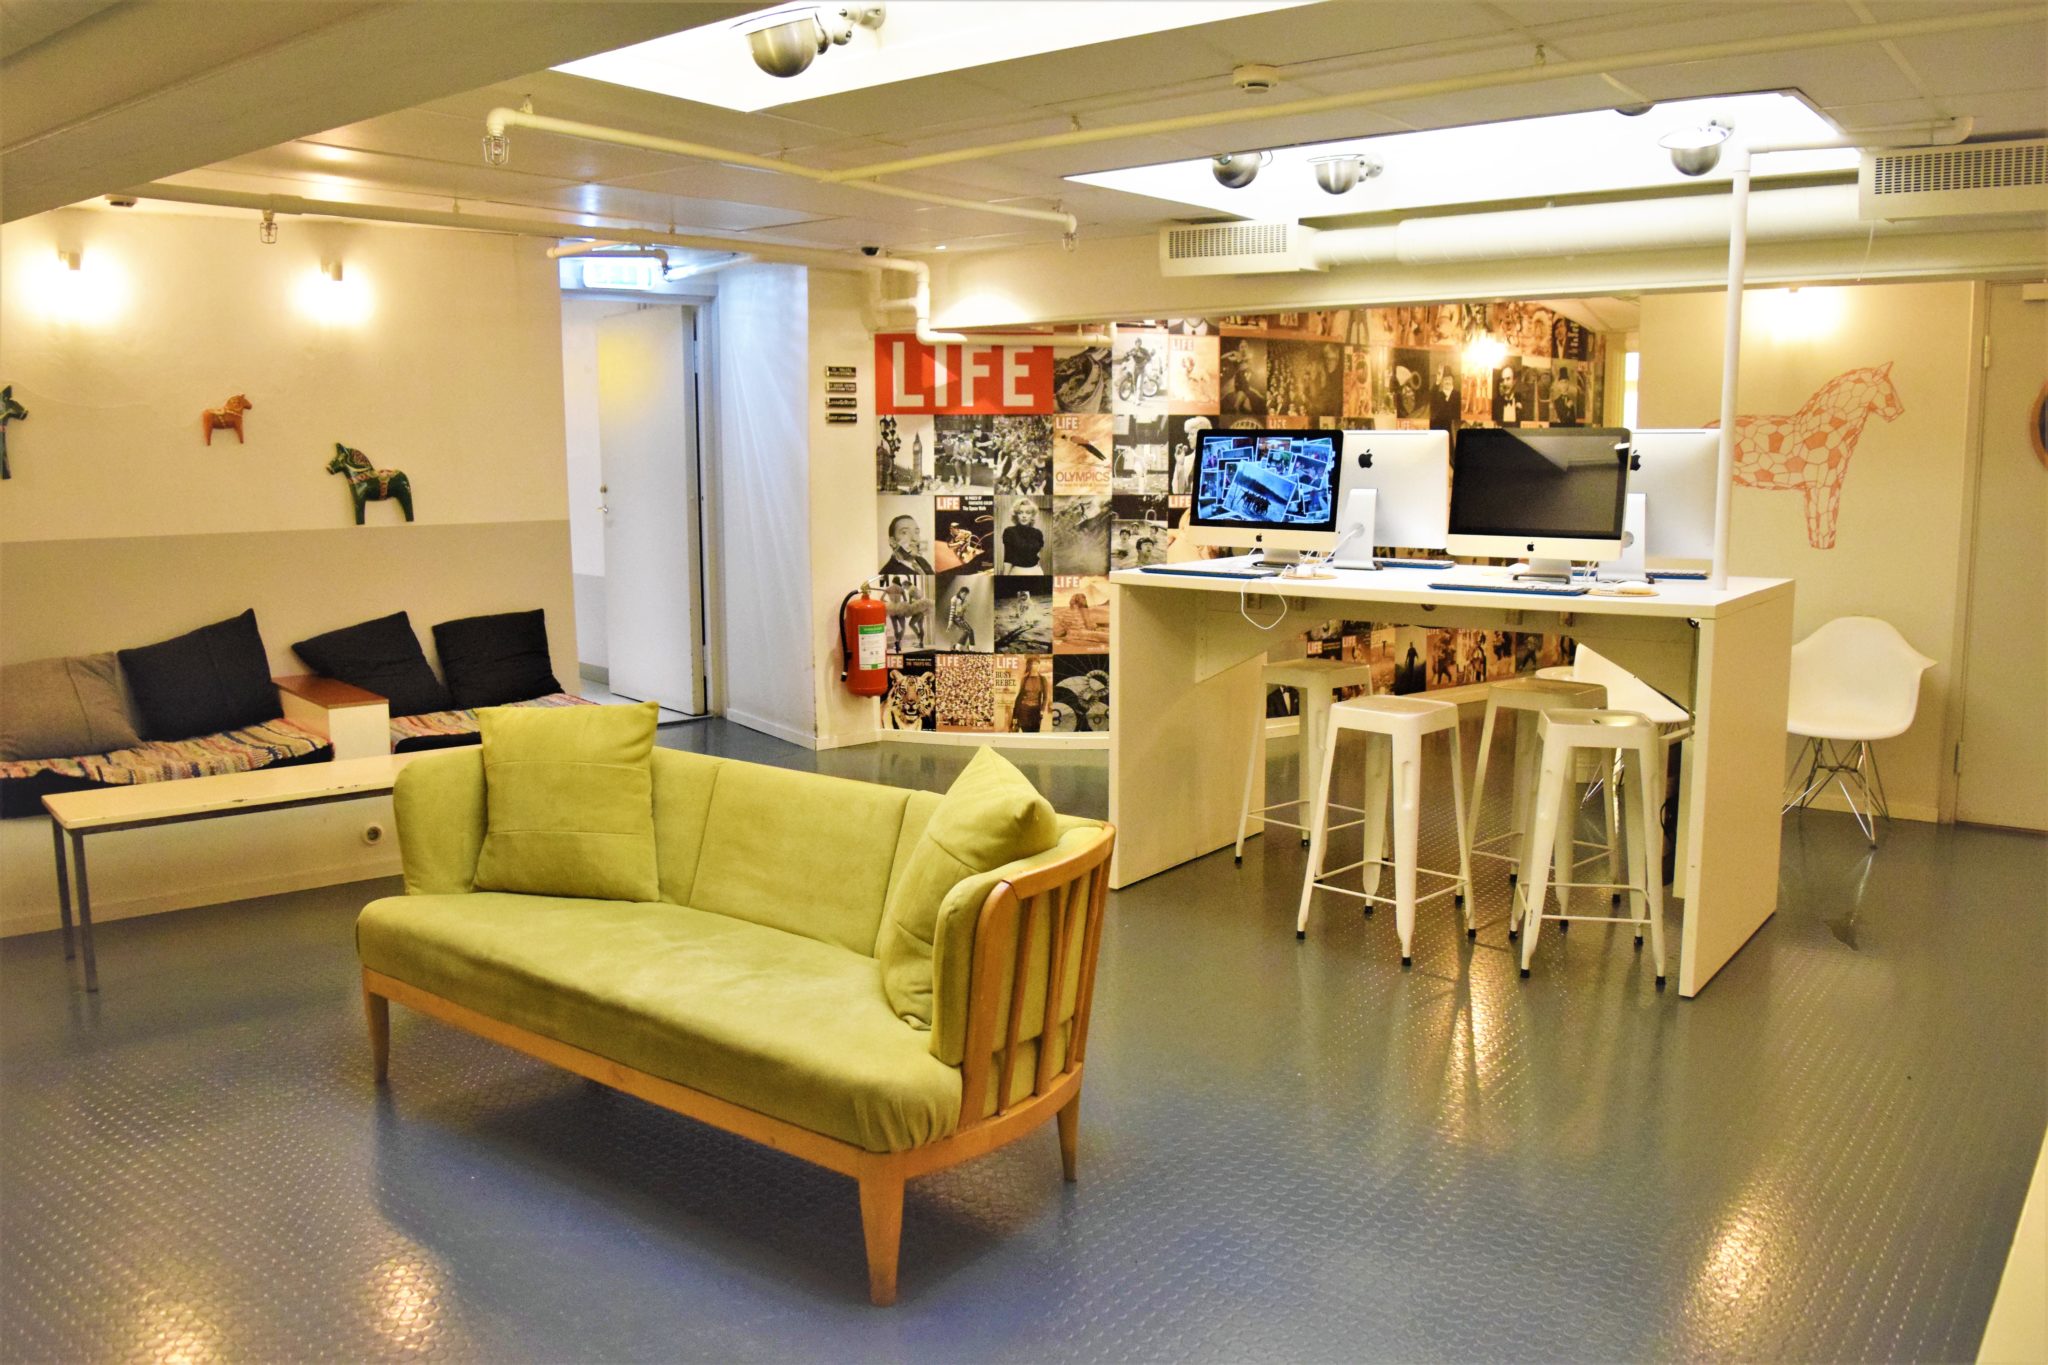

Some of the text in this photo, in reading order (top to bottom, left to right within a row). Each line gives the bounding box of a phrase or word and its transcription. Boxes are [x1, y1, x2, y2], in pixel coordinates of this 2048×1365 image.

[893, 342, 1034, 407] LIFE
[1055, 417, 1079, 430] LIFE
[1055, 471, 1111, 482] OLYMPICS
[936, 496, 960, 510] LIFE
[1168, 495, 1191, 508] LIFE
[1054, 576, 1080, 588] LIFE
[1307, 641, 1323, 654] LIFE
[887, 656, 903, 668] IFE
[937, 656, 960, 667] LIFE
[996, 657, 1018, 669] LIFE
[996, 671, 1012, 679] BUSY
[996, 679, 1016, 687] REBEL
